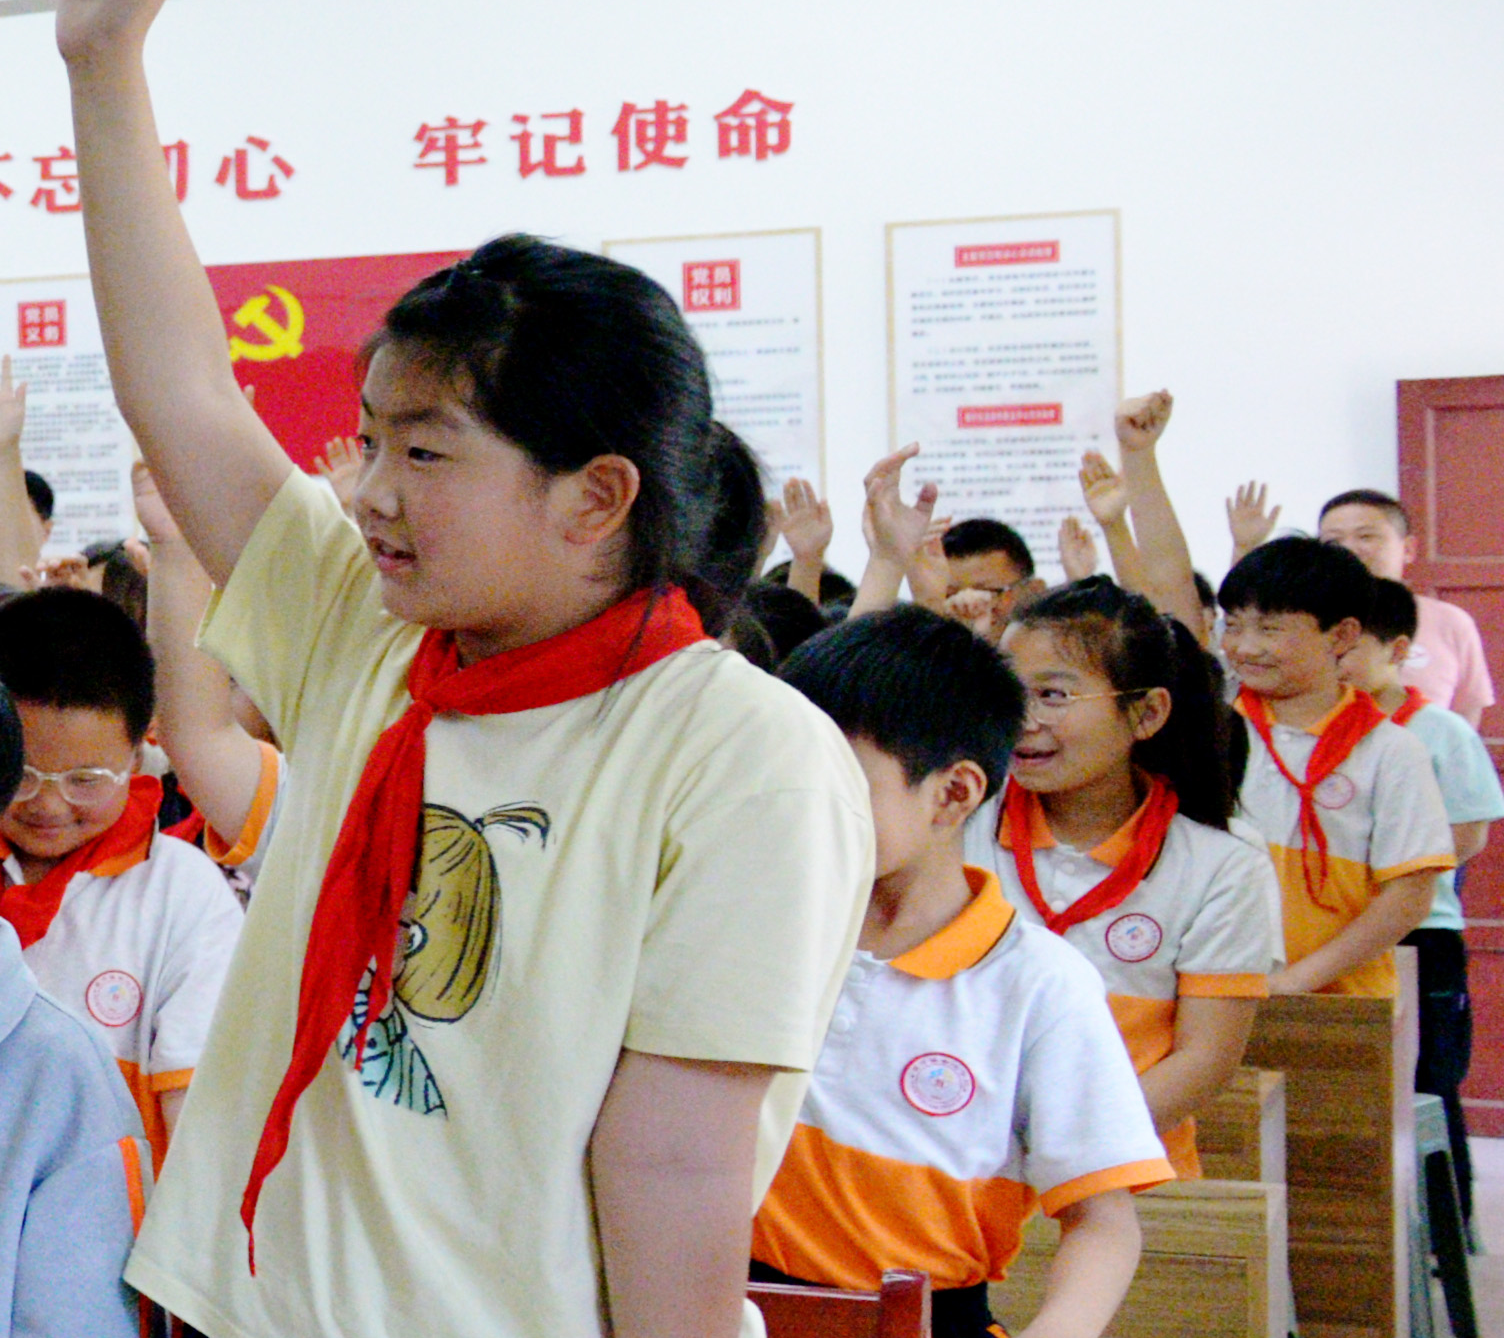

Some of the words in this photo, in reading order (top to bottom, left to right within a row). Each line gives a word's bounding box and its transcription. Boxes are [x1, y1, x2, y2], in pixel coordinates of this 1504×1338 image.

[413, 88, 796, 187] 牢记使命
[691, 266, 732, 285] 党员
[691, 287, 732, 306] 权利
